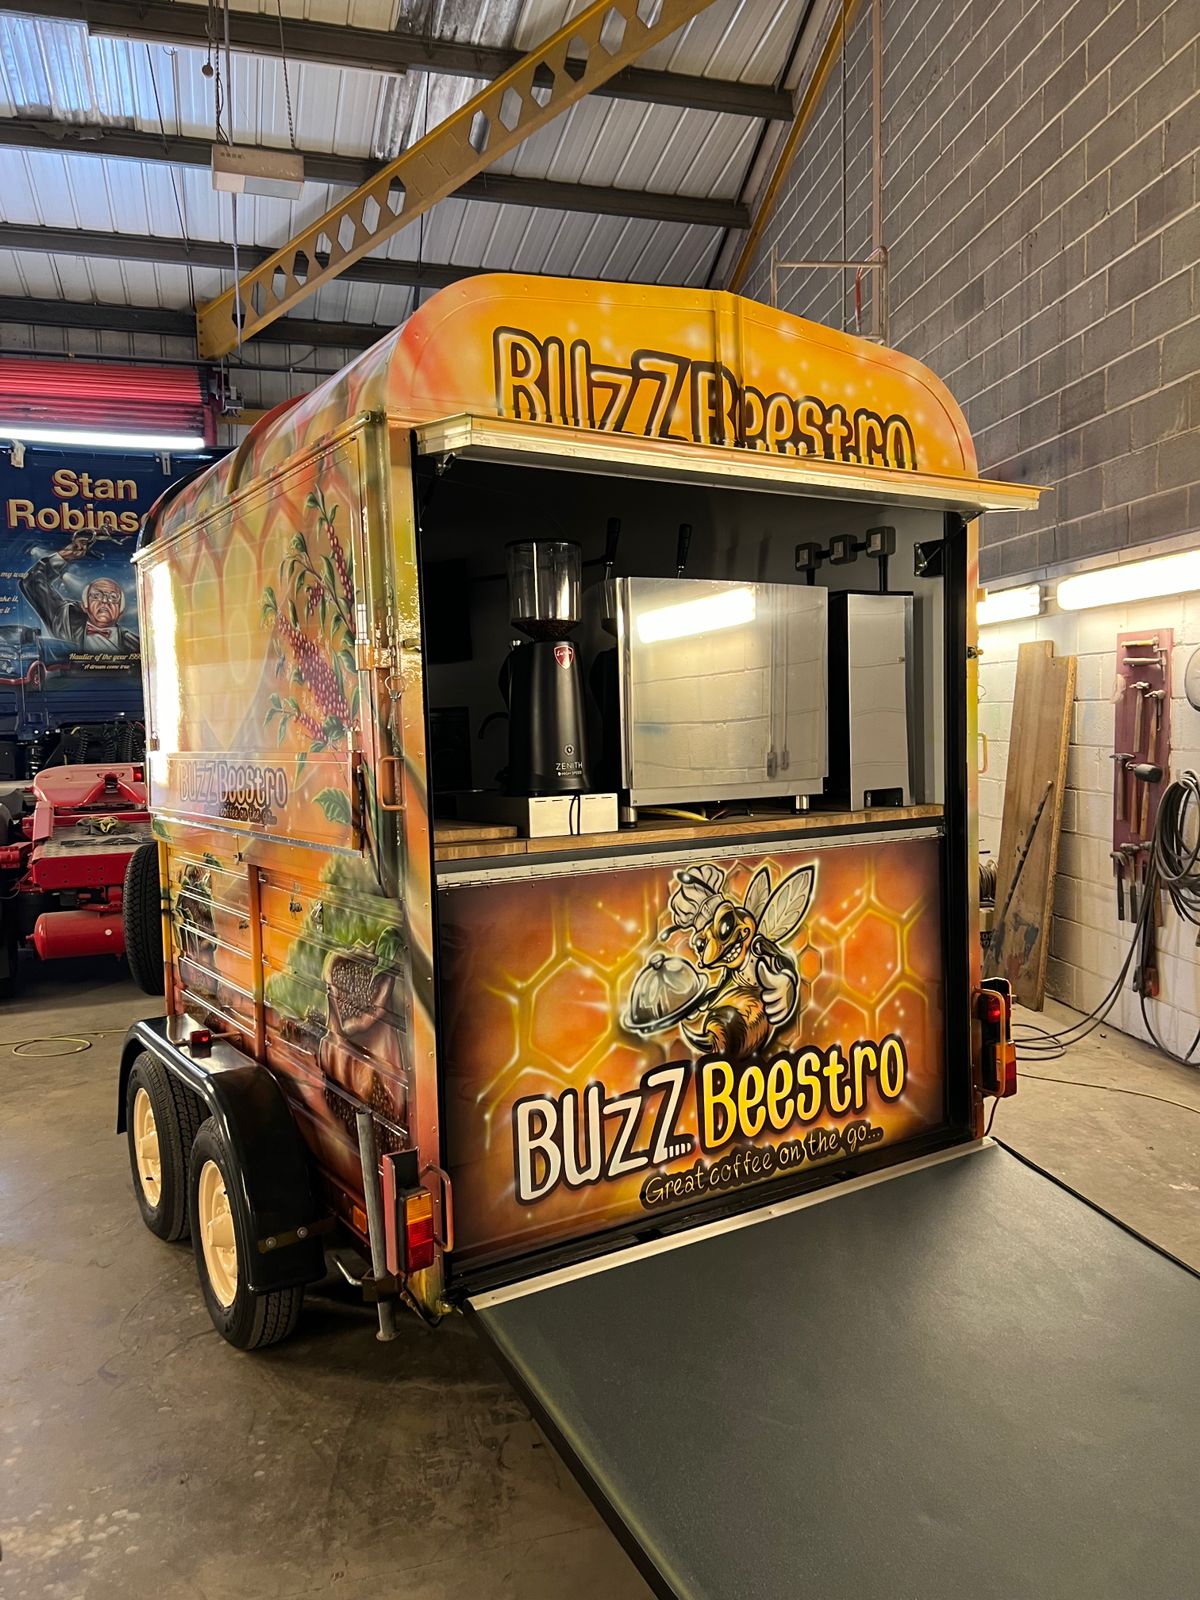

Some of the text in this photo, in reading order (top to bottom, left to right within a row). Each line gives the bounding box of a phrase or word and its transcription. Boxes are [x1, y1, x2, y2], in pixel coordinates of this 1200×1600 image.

[53, 469, 138, 500] Stan
[218, 762, 287, 808] Beestro
[555, 761, 583, 770] ZENITH
[702, 1037, 905, 1149] Beestro
[645, 1166, 705, 1204] Great
[709, 1148, 773, 1186] coffee
[778, 1145, 801, 1165] on
[807, 1130, 838, 1157] the
